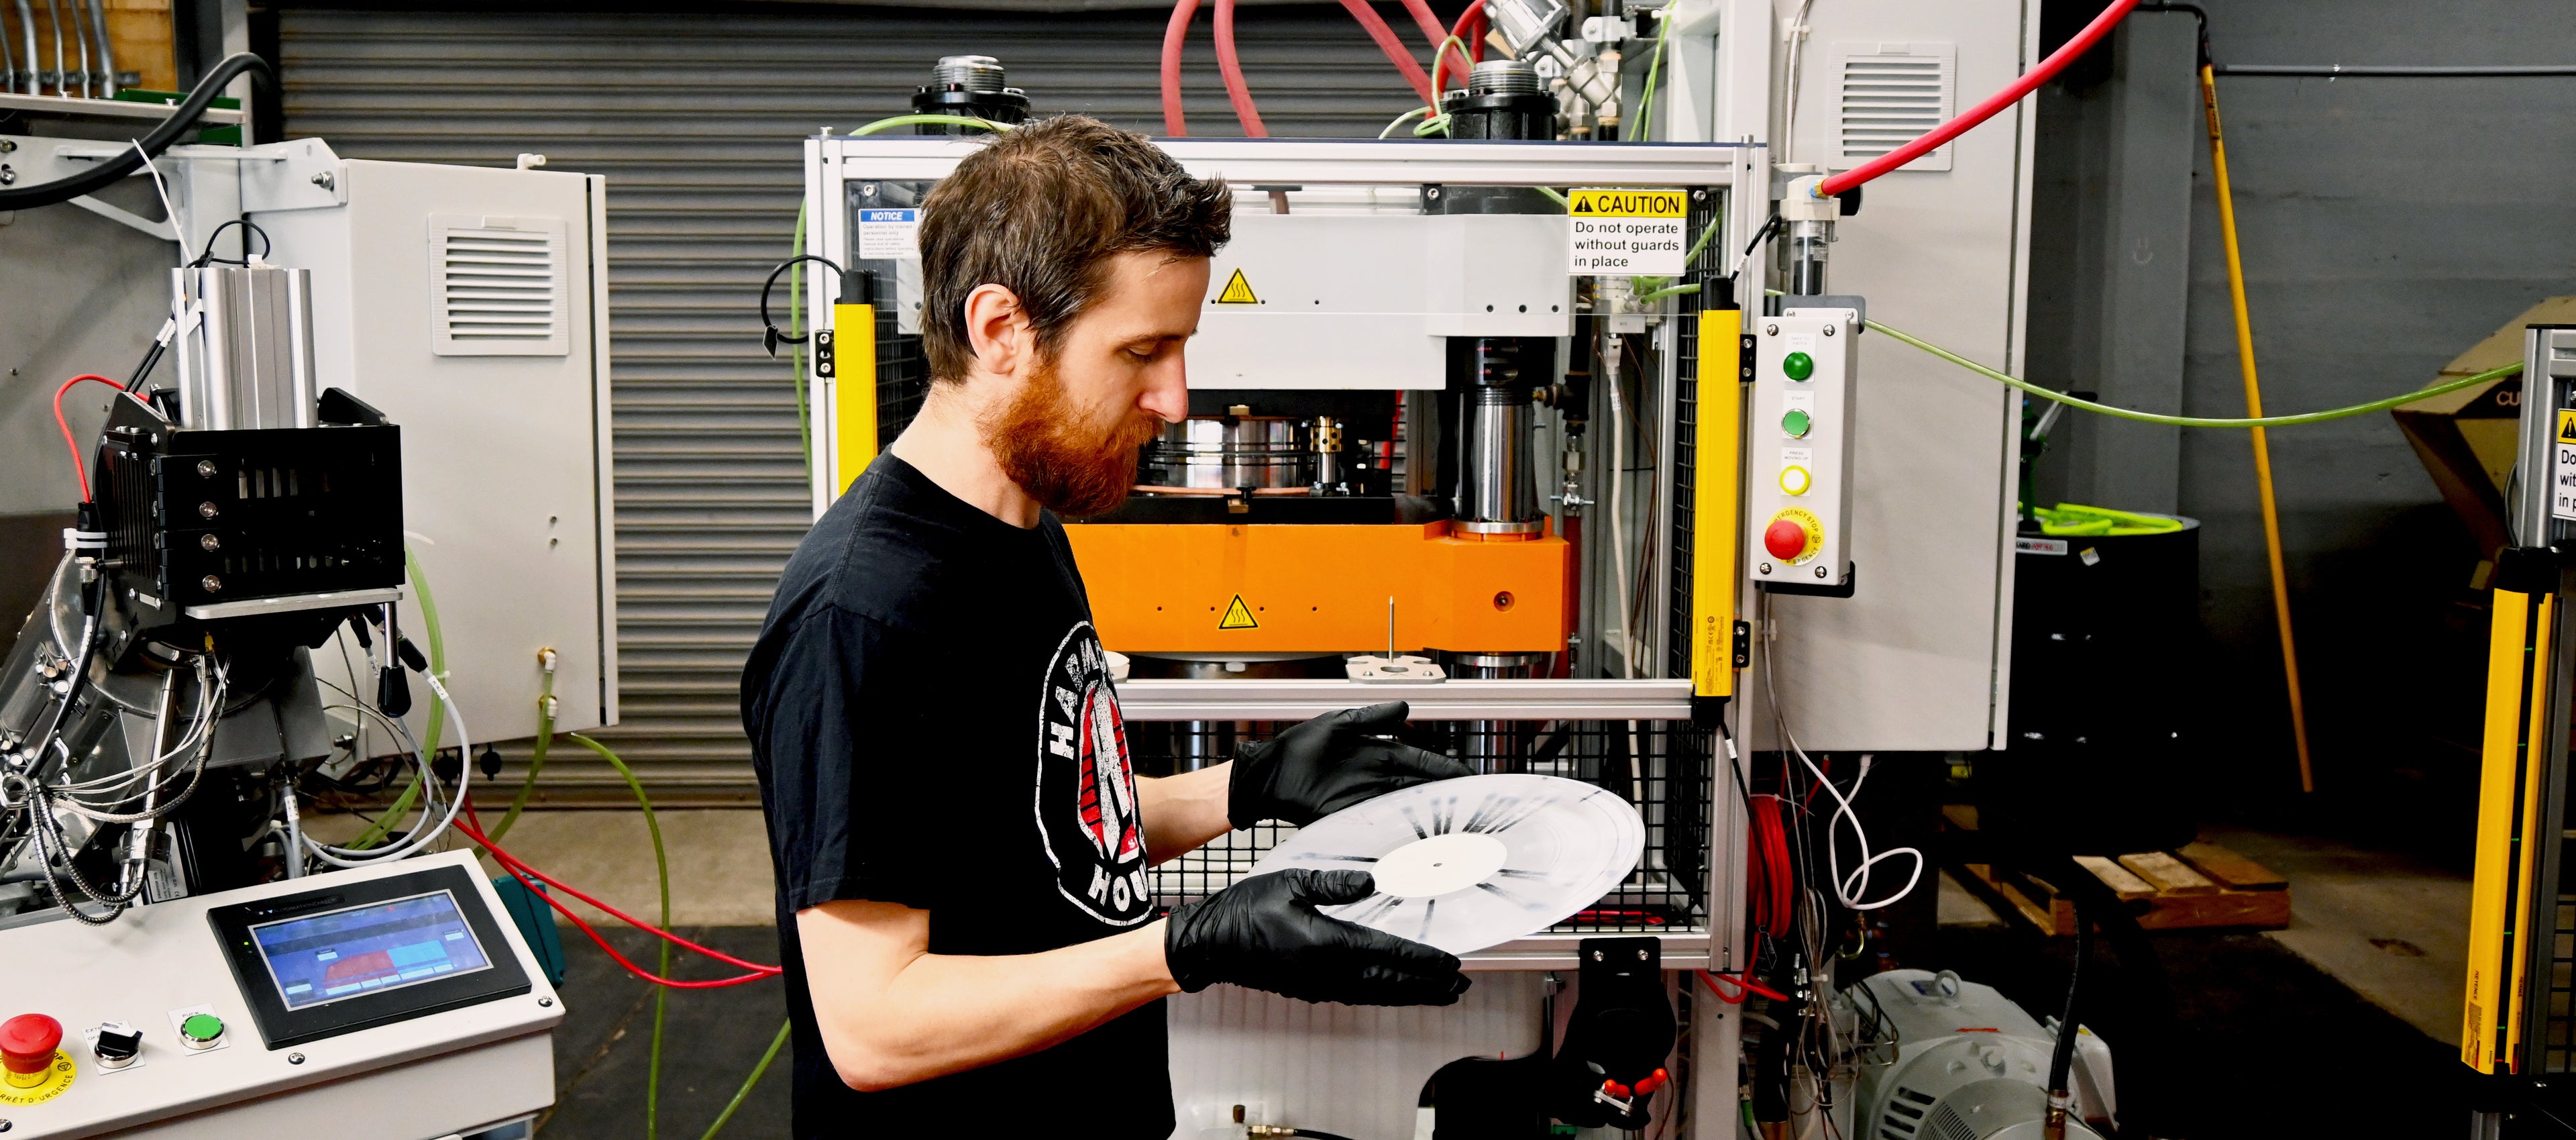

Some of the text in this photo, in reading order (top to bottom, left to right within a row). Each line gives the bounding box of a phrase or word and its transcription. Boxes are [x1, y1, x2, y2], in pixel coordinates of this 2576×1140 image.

[1598, 195, 1680, 213] CAUTION
[871, 211, 903, 221] NOTICE
[1576, 221, 1678, 236] Do not operate
[1575, 239, 1679, 253] without guards
[1575, 256, 1628, 269] in place
[2559, 493, 2569, 507] in
[1807, 516, 1819, 532] STOP
[28, 1075, 72, 1103] D'URGENCE
